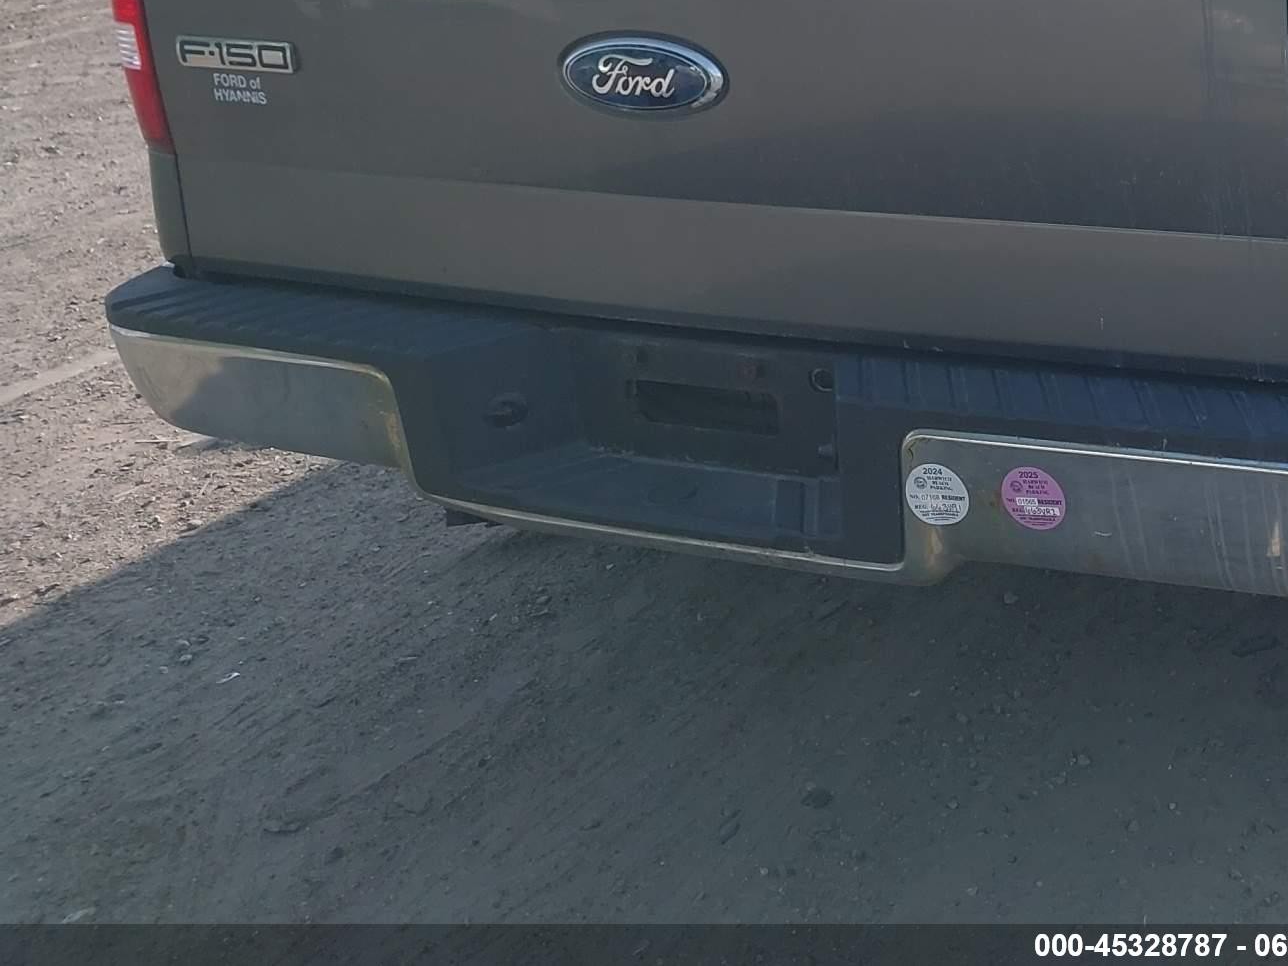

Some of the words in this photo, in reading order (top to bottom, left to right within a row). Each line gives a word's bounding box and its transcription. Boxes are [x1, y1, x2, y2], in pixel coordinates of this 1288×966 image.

[213, 73, 247, 88] FORD
[249, 77, 262, 90] of
[591, 53, 676, 98] Ford
[214, 88, 267, 105] HYANNIS
[922, 467, 943, 475] 2024
[1018, 471, 1039, 479] 2025
